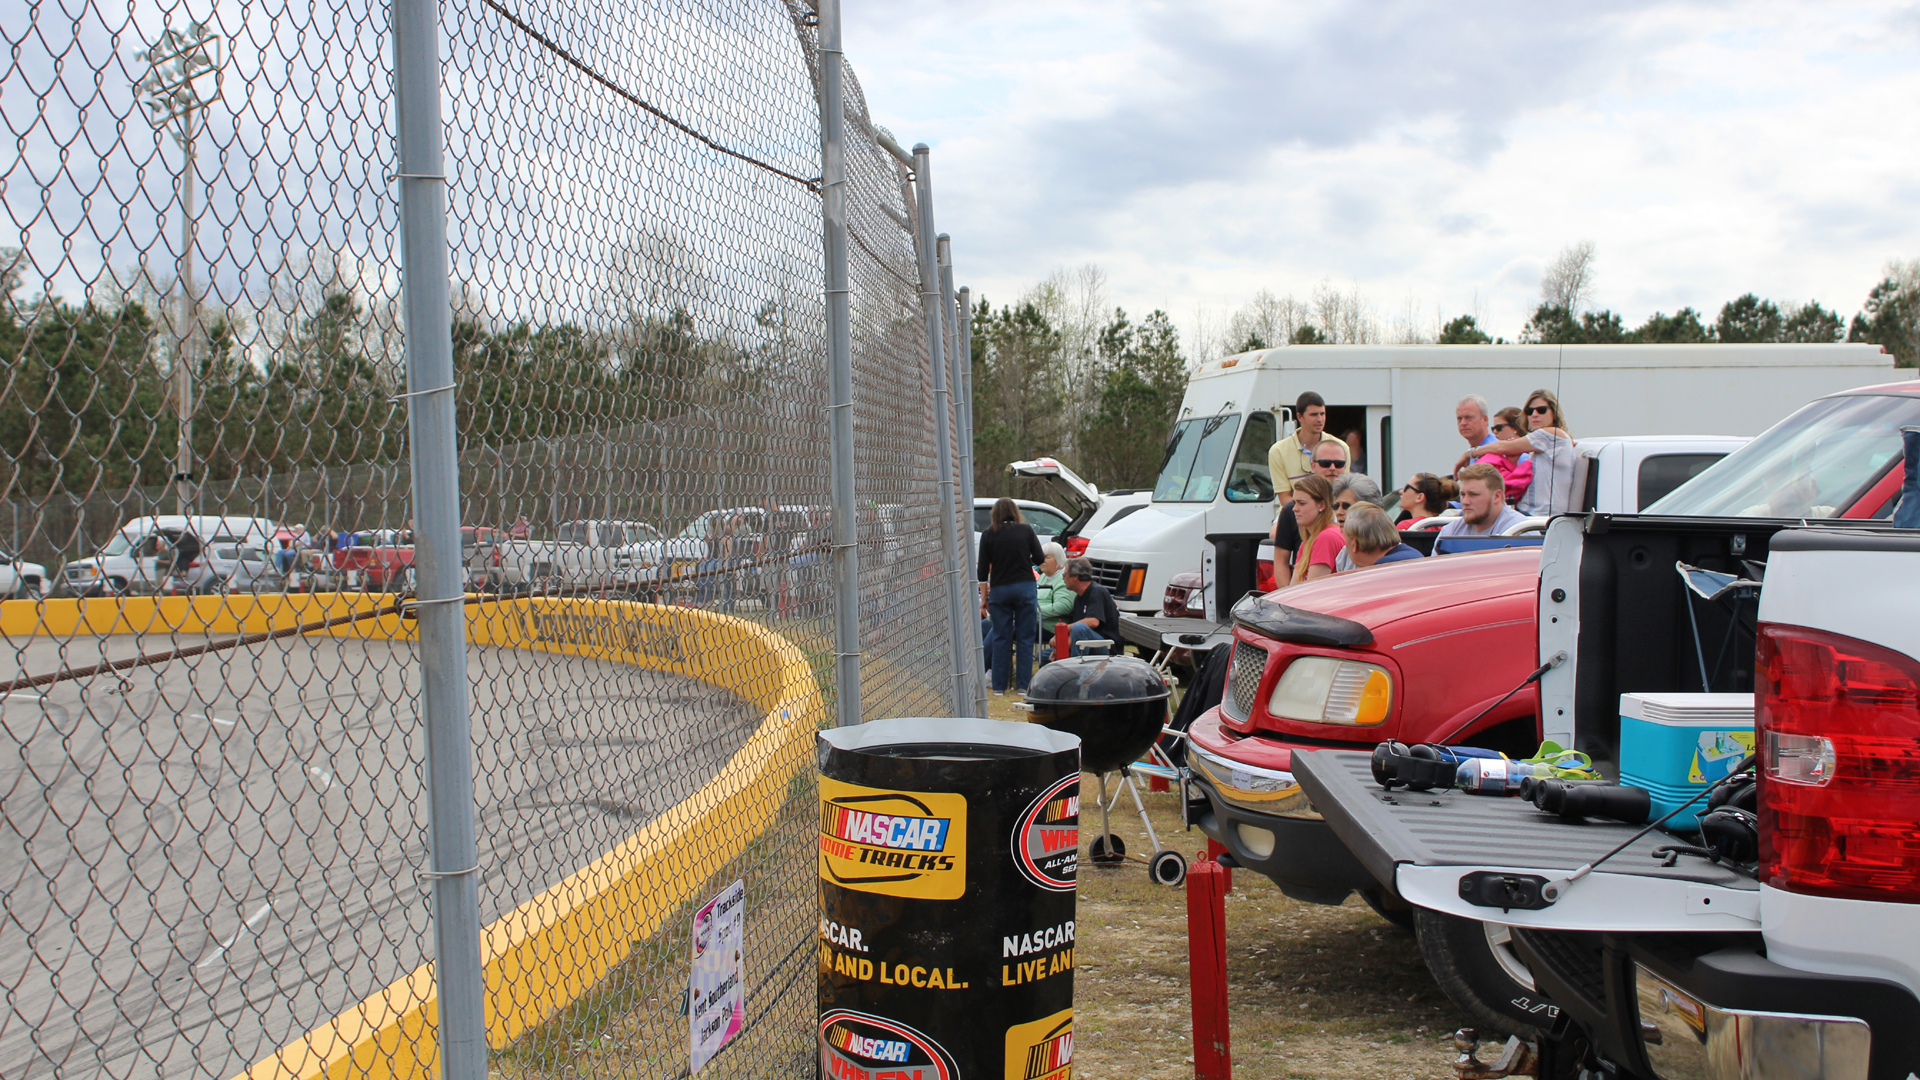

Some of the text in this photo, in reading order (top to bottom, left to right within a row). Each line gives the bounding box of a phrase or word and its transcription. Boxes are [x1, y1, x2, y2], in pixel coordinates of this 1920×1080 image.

[530, 602, 615, 648] Southern
[844, 810, 941, 851] NASCAR
[859, 847, 956, 871] TRACKS
[717, 887, 743, 918] Trackside
[820, 915, 869, 952] SCAR.
[709, 966, 738, 1009] Southerland
[835, 952, 874, 981] AND
[880, 961, 969, 990] LOCAL.
[1002, 957, 1047, 986] LIVE
[700, 1015, 721, 1046] Jackson
[848, 1032, 907, 1062] NASCAR
